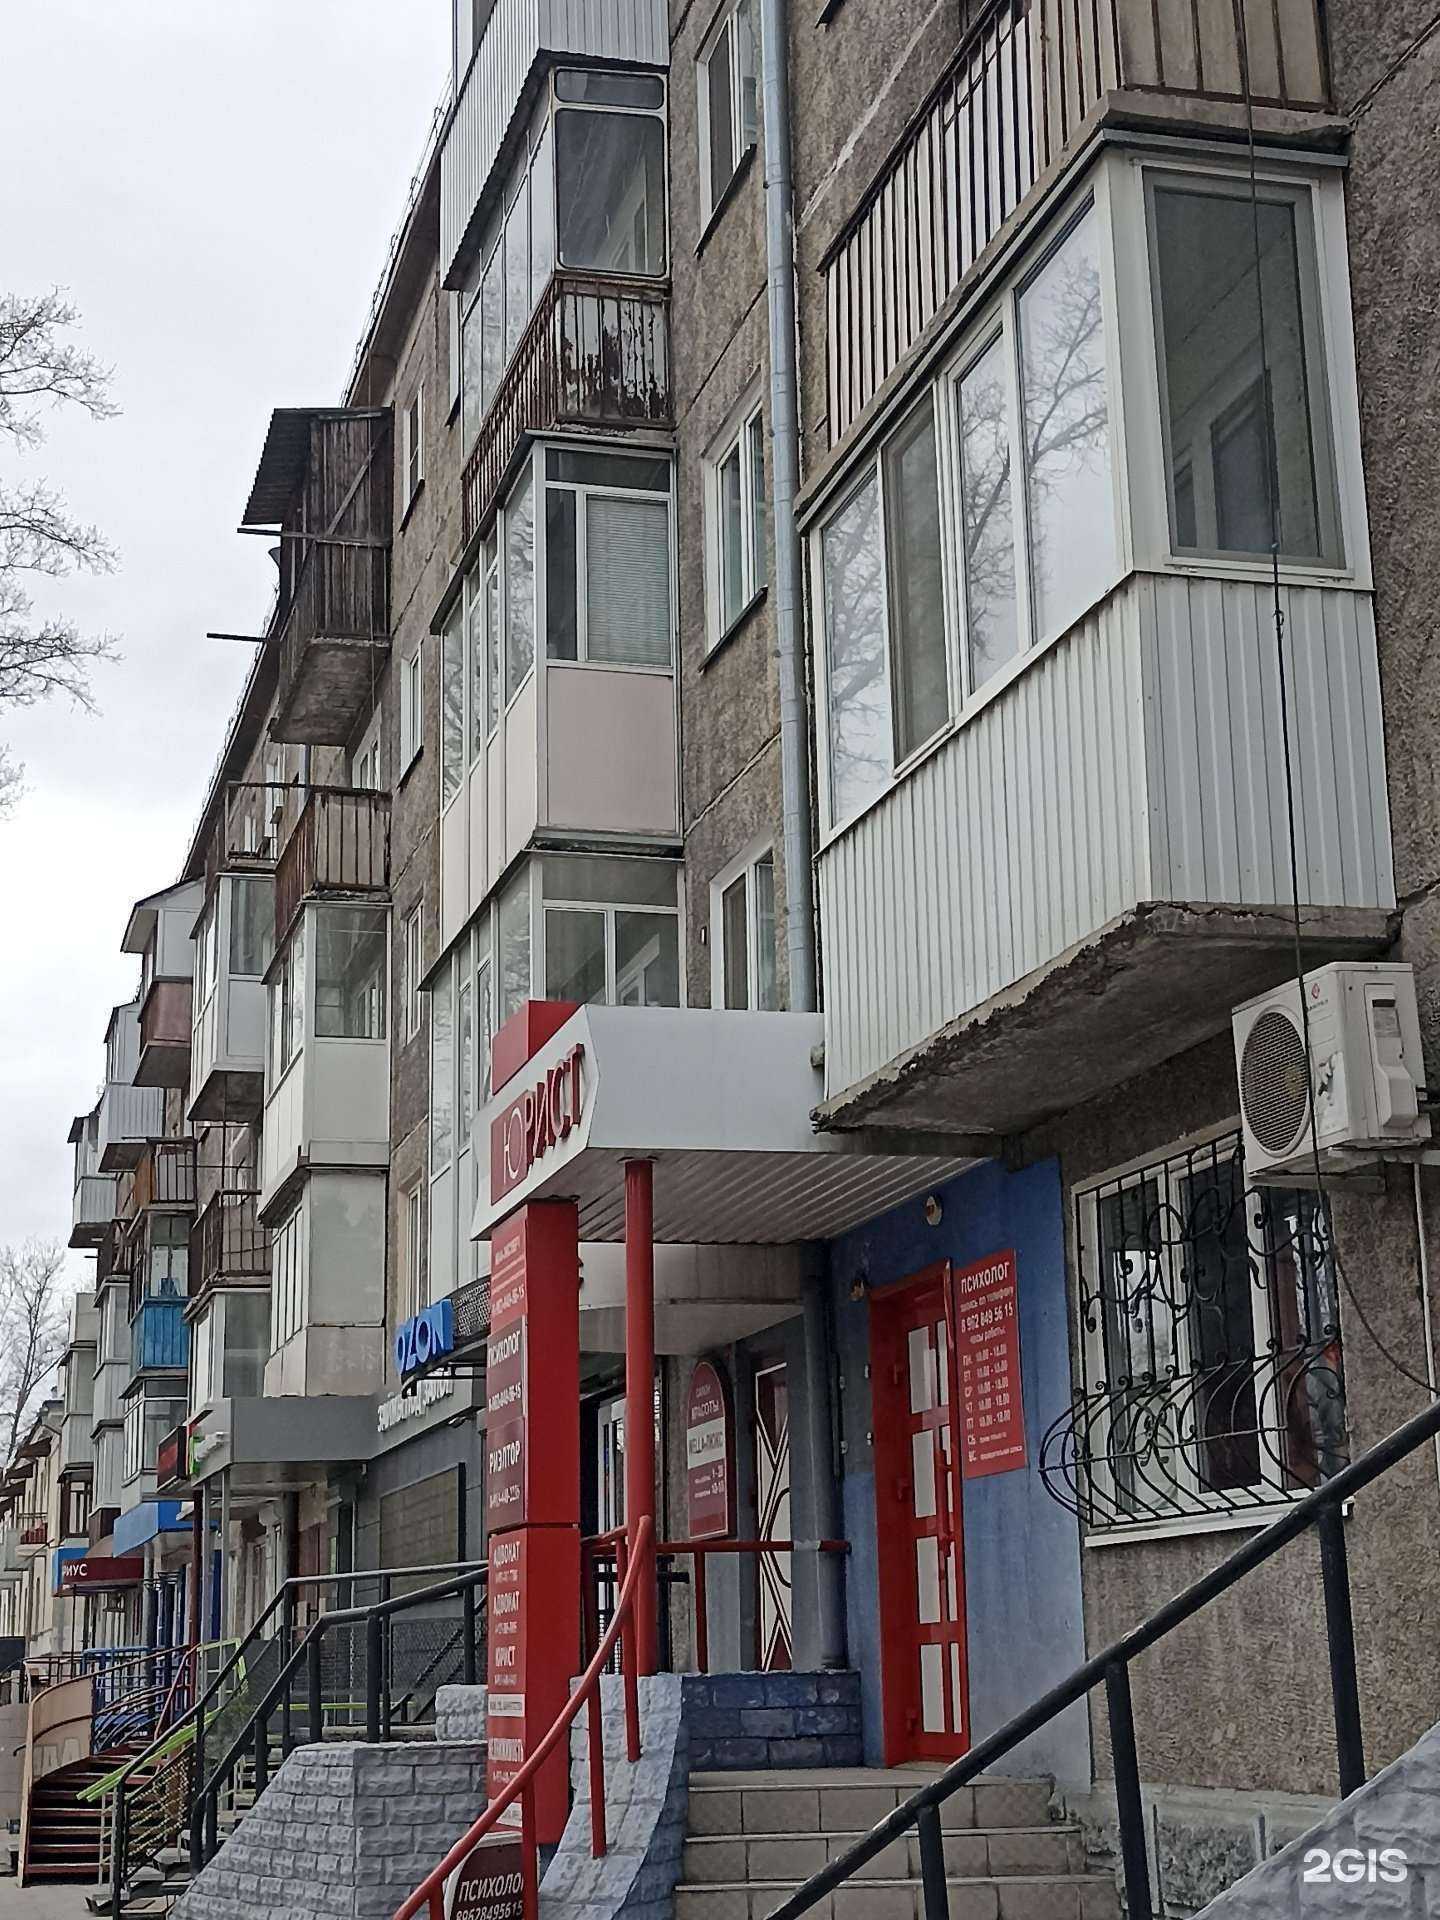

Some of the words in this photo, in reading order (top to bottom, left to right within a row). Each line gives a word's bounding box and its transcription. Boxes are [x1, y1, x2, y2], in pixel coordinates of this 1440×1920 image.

[503, 1043, 585, 1185] ЮРИСТ
[961, 1261, 1010, 1294] ПСИХОЛОГ
[1004, 1301, 1013, 1318] 15
[395, 1298, 454, 1375] OZON
[489, 1440, 520, 1475] РИЭЛТОР
